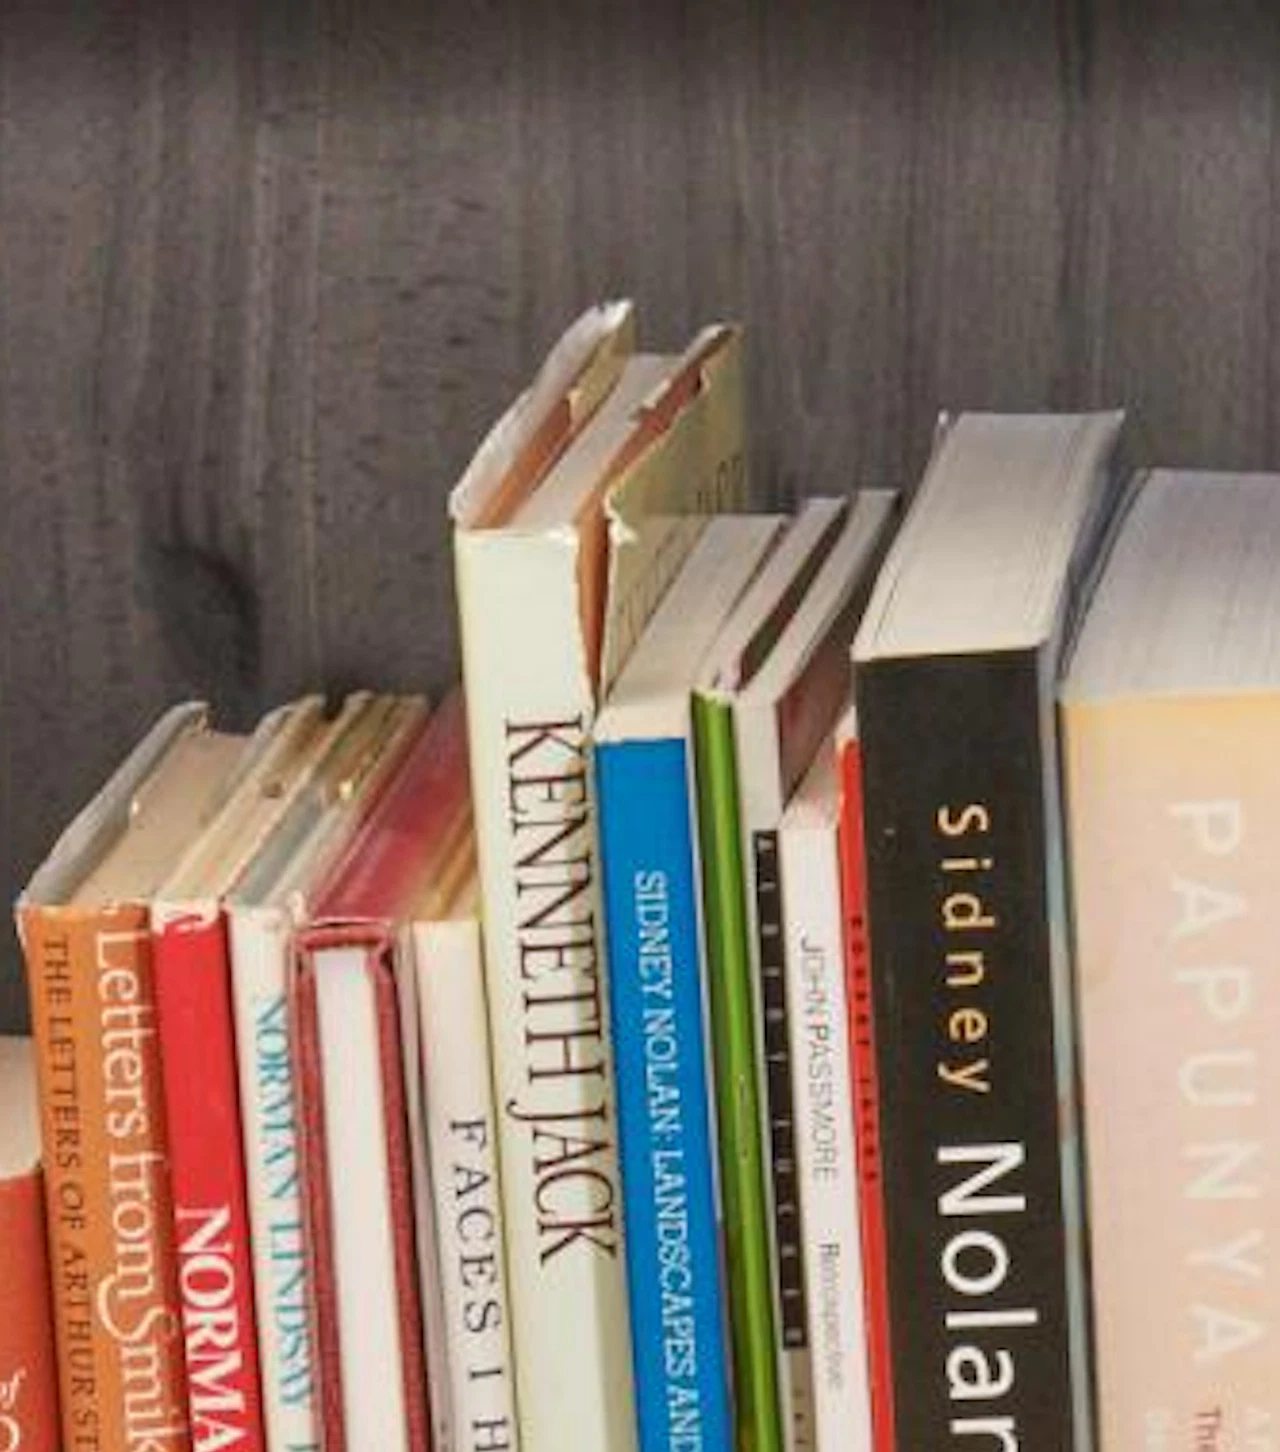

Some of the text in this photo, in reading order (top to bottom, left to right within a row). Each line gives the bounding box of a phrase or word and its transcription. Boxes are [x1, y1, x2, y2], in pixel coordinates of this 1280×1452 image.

[42, 934, 73, 1001] THE
[506, 713, 617, 1268] KENNETH JACK
[635, 870, 674, 999] SIDNEY
[49, 1016, 86, 1169] LETTERS
[94, 931, 159, 1138] Letters
[254, 994, 302, 1204] NORMAN
[643, 1007, 680, 1143] NOLAN:
[800, 936, 841, 1184] JOHN PASSMORE
[1168, 798, 1268, 1368] PAPUNYA
[58, 1181, 86, 1230] OF
[107, 1153, 171, 1301] from
[450, 1118, 503, 1335] FACES
[653, 1150, 698, 1376] LANDSCAPES
[62, 1246, 98, 1394] ARTHUR
[268, 1219, 317, 1411] LINDSAY
[468, 1367, 505, 1384] I
